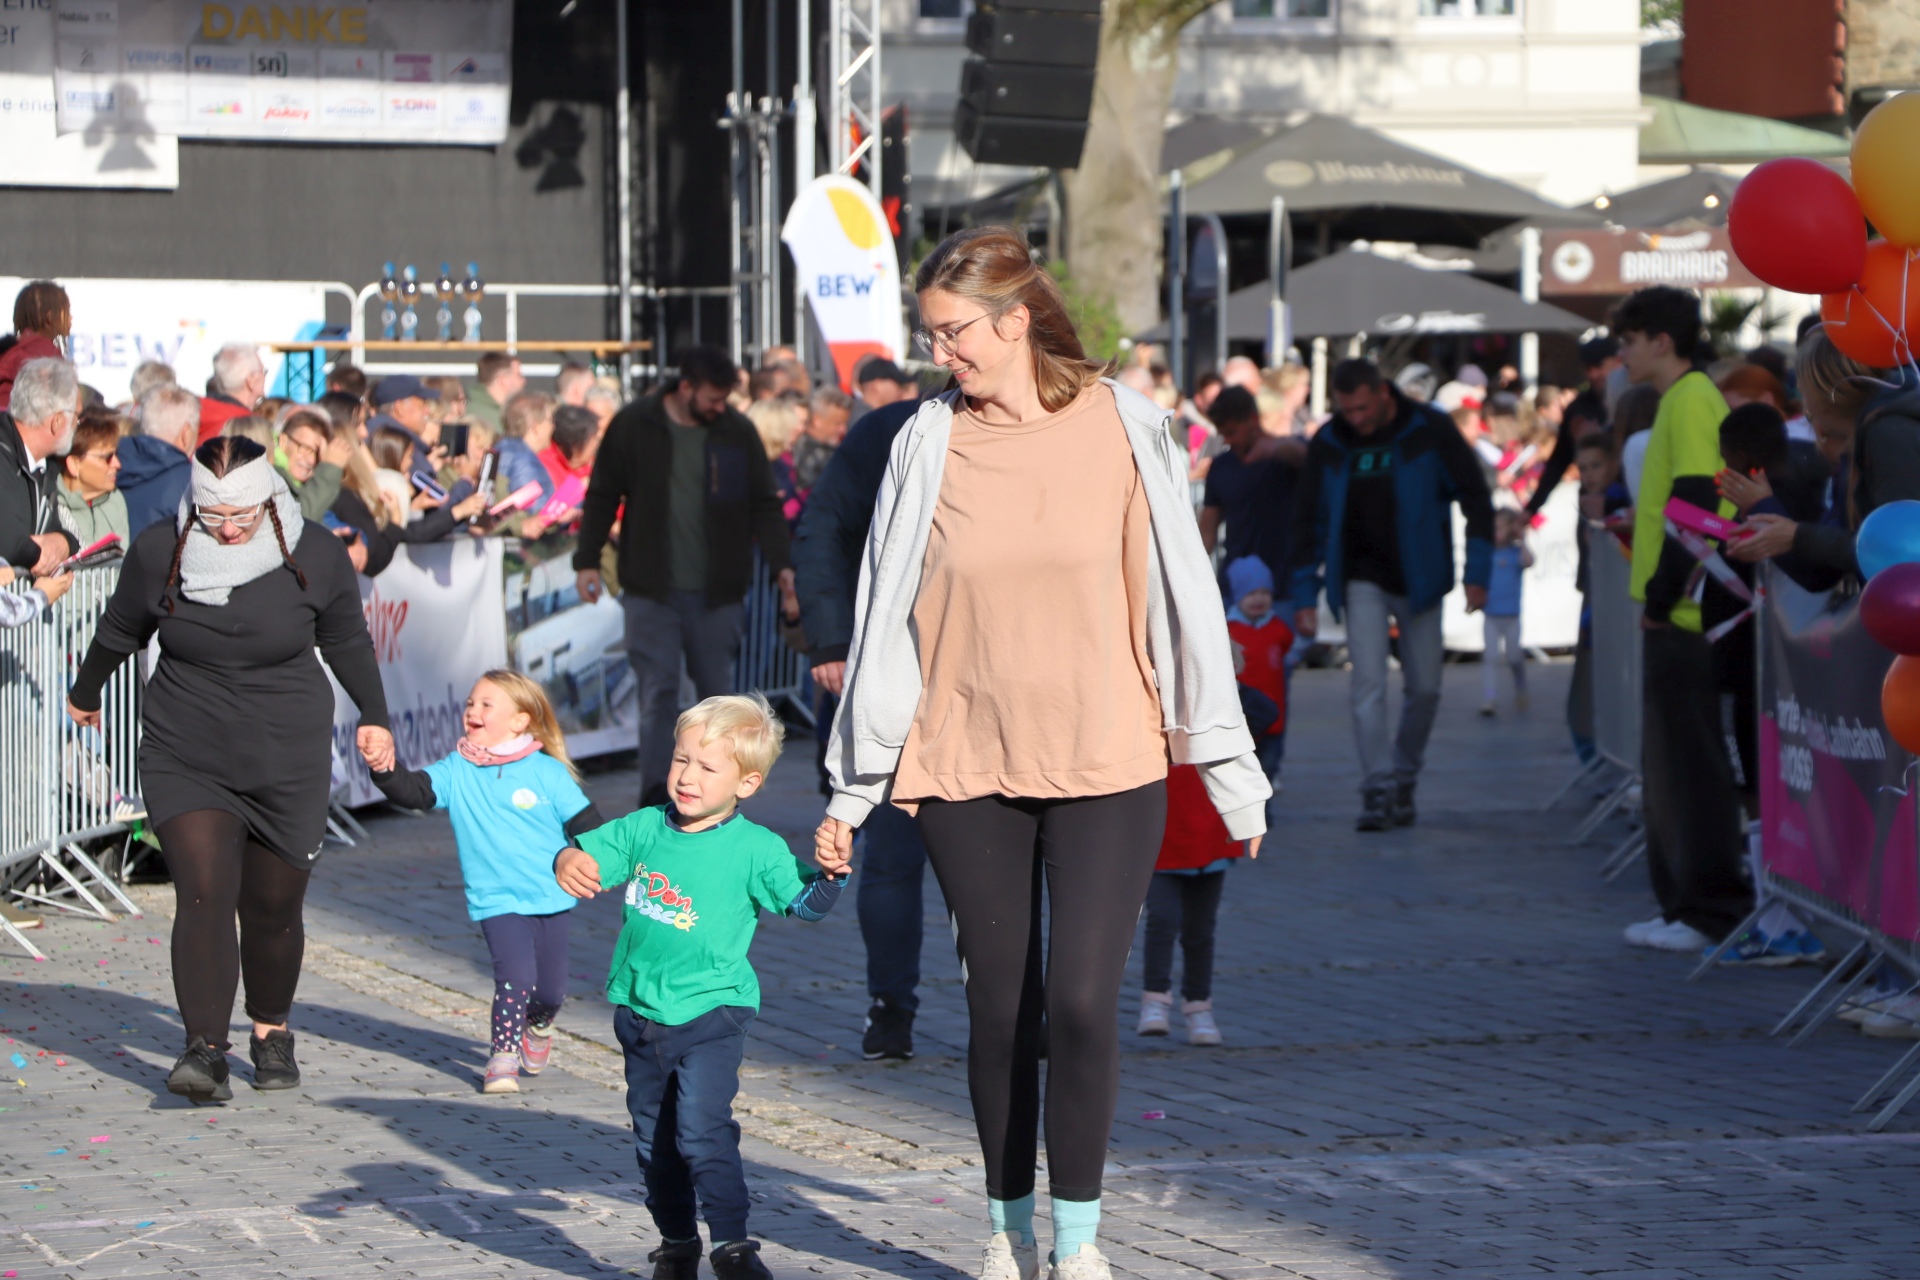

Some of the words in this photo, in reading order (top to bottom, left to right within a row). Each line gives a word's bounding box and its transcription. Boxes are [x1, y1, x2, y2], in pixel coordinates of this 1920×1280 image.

[202, 4, 368, 43] DANKE
[1620, 250, 1729, 284] BRAUHAUS
[818, 274, 876, 297] BEW
[67, 332, 186, 368] BEW
[648, 872, 693, 912] Don
